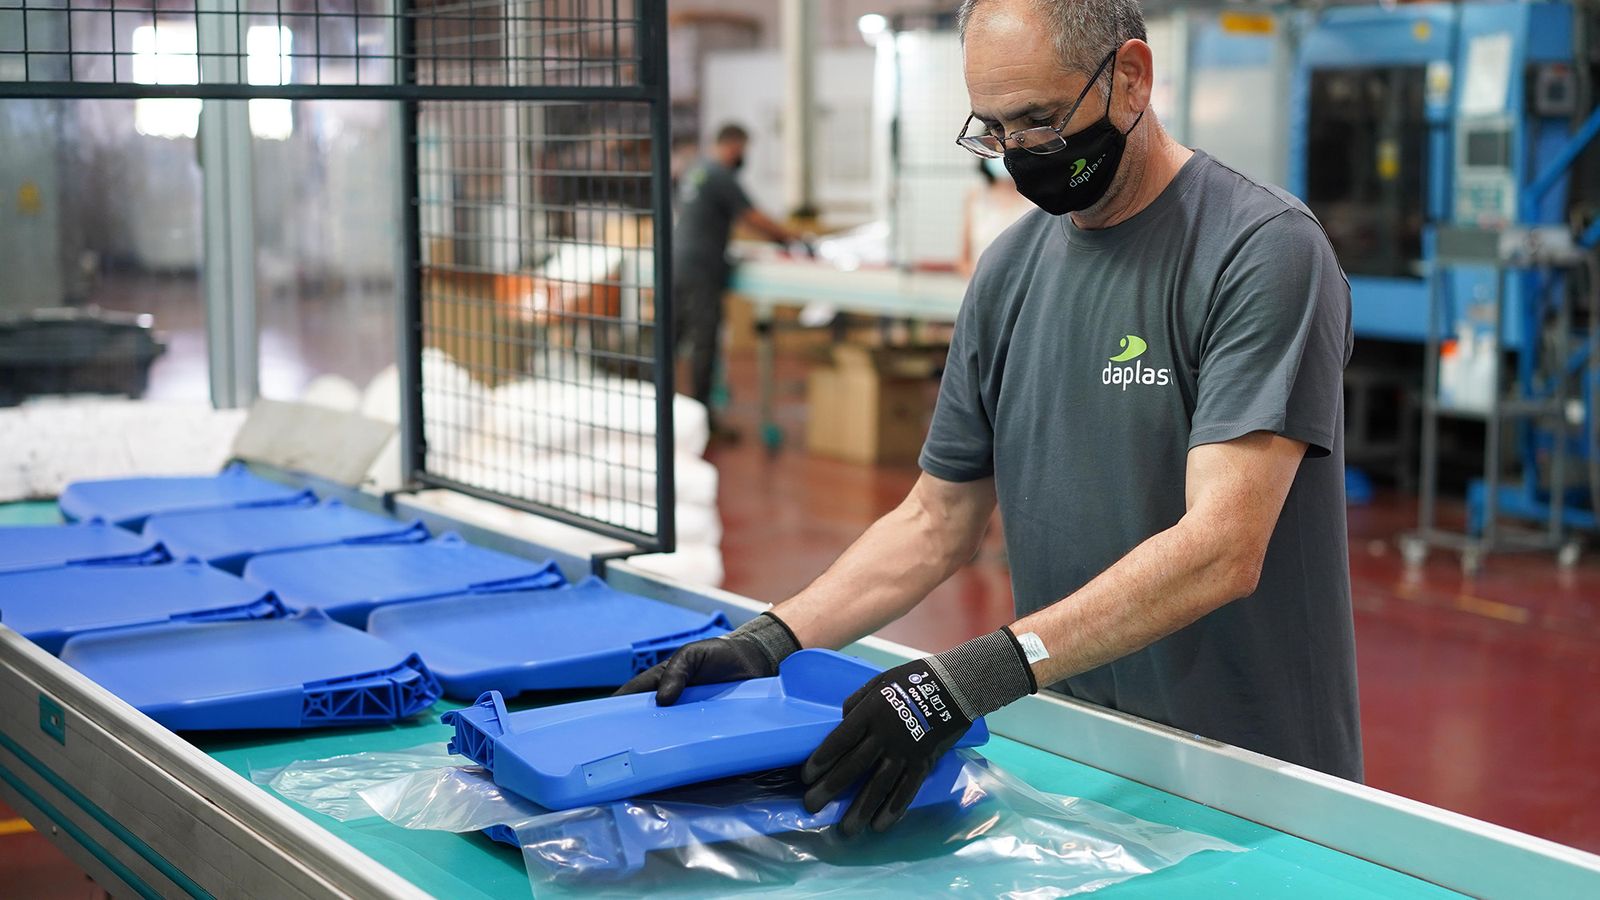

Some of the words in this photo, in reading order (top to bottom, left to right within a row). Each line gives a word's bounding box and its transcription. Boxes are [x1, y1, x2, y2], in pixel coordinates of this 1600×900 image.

[1069, 153, 1107, 188] dapla
[1102, 359, 1174, 391] daplas
[880, 687, 926, 742] ECOPU
[908, 687, 933, 717] PU1400
